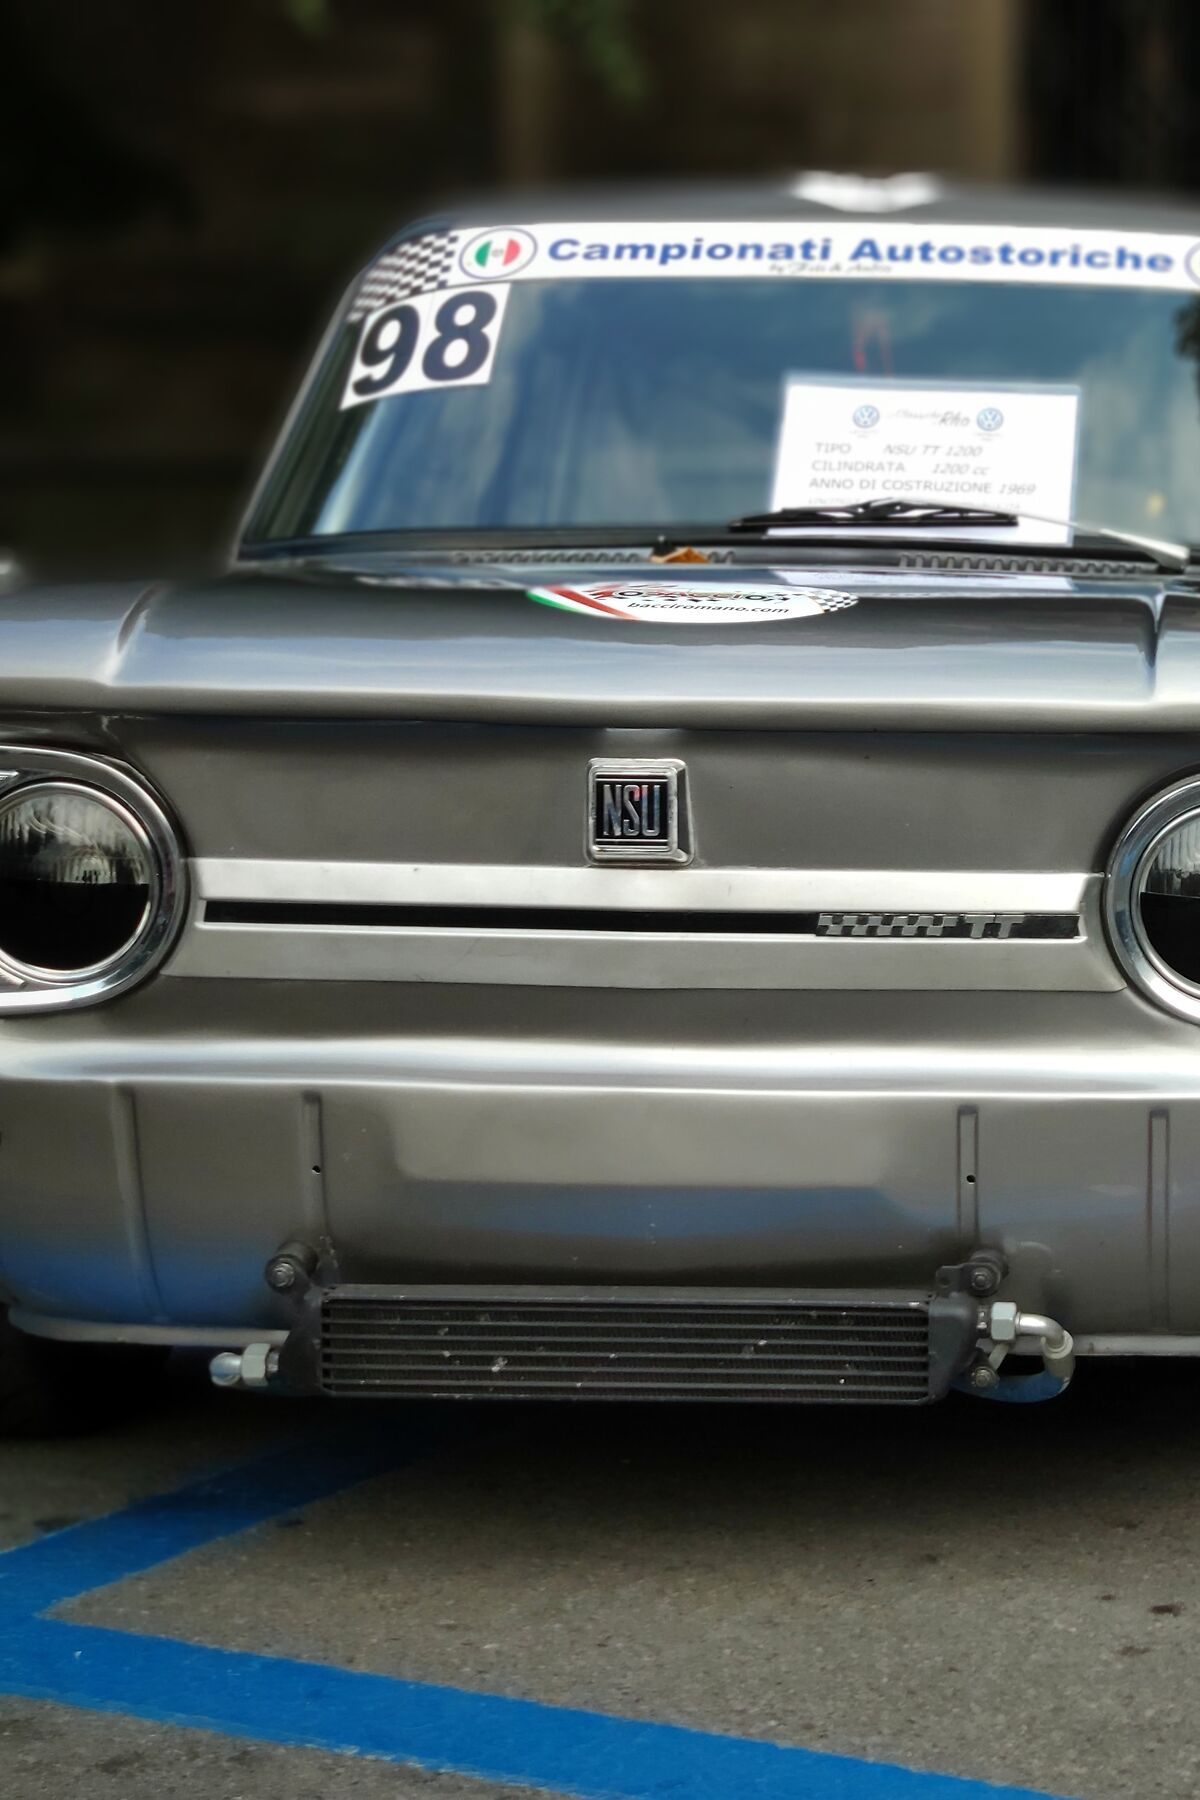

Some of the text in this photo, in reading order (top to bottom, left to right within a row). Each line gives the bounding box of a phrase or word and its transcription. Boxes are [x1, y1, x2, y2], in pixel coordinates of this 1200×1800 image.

[548, 238, 831, 264] Campionati
[850, 238, 1173, 272] Autostoriche
[353, 291, 498, 396] 98
[815, 442, 983, 457] TIPO NSU TT 1200
[811, 460, 990, 476] CILINDRATA 1200 cc
[808, 478, 1036, 495] ANNO DI COSTRUZIONE 1969
[627, 602, 789, 614] bacciromano.com
[602, 784, 661, 837] NSU
[965, 914, 1023, 938] TT
